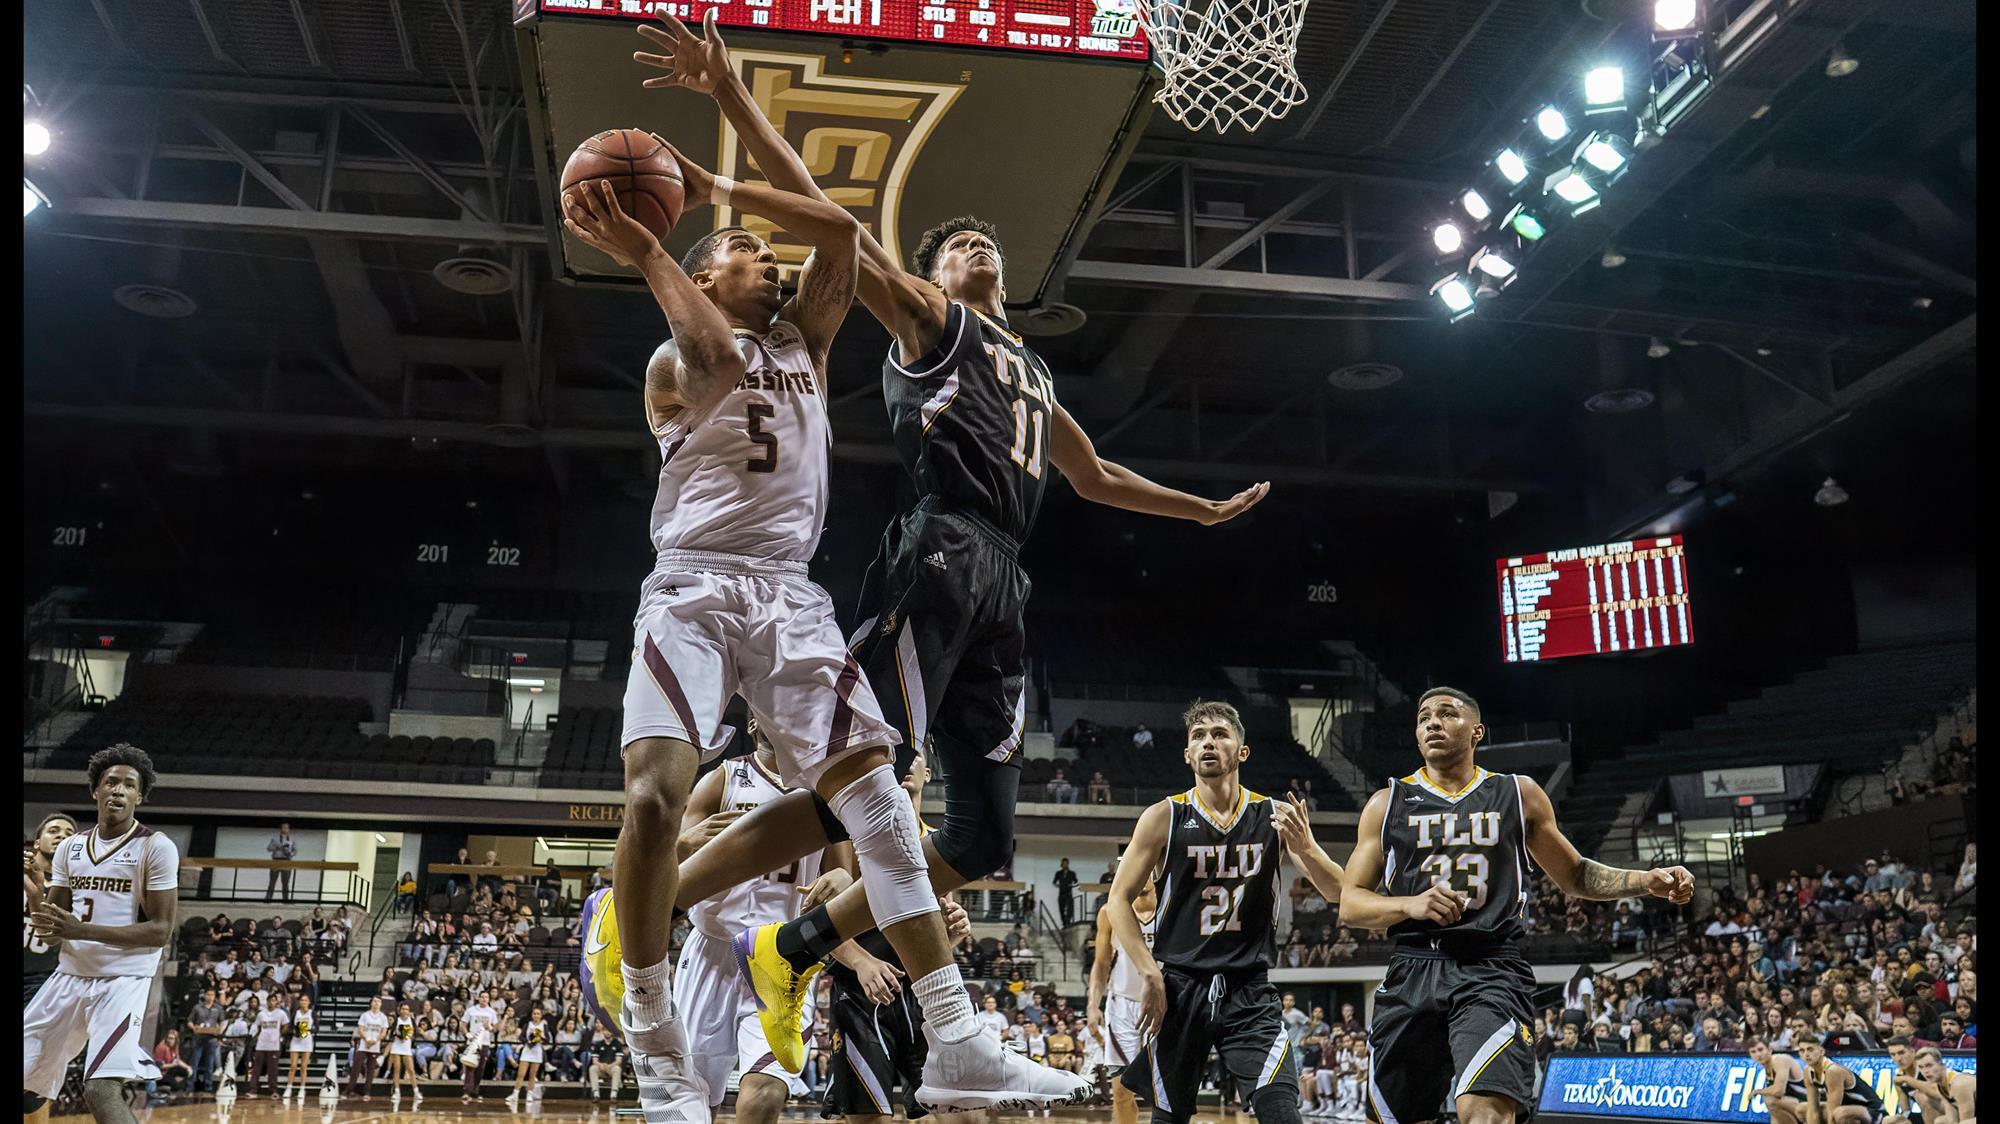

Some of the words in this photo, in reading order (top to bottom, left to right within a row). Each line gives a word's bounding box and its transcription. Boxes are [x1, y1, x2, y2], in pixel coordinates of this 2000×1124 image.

[644, 2, 654, 14] 4
[679, 4, 689, 16] 3
[752, 9, 769, 25] 10
[871, 0, 881, 26] 1
[933, 23, 944, 39] 0
[977, 27, 989, 42] 4
[1030, 33, 1039, 46] 3
[1062, 36, 1073, 49] 7
[1079, 36, 1120, 52] BONUS
[761, 367, 816, 396] STATE
[982, 341, 1053, 416] TLU
[747, 403, 778, 473] 5
[1010, 398, 1043, 480] 11
[53, 526, 86, 546] 201
[416, 543, 449, 563] 201
[487, 547, 521, 566] 202
[1547, 548, 1579, 563] PLAYER
[1579, 544, 1606, 560] GAME
[1606, 541, 1634, 556] STATS
[1308, 584, 1338, 602] 203
[1407, 811, 1501, 849] TLU
[1186, 842, 1264, 879] TLU
[69, 875, 92, 890] TEXAS
[91, 877, 133, 893] STATE
[1420, 852, 1489, 910] 33
[1199, 884, 1246, 936] 21
[1563, 1083, 1600, 1103] TEXAS
[1613, 1084, 1694, 1109] ONCOLOGY
